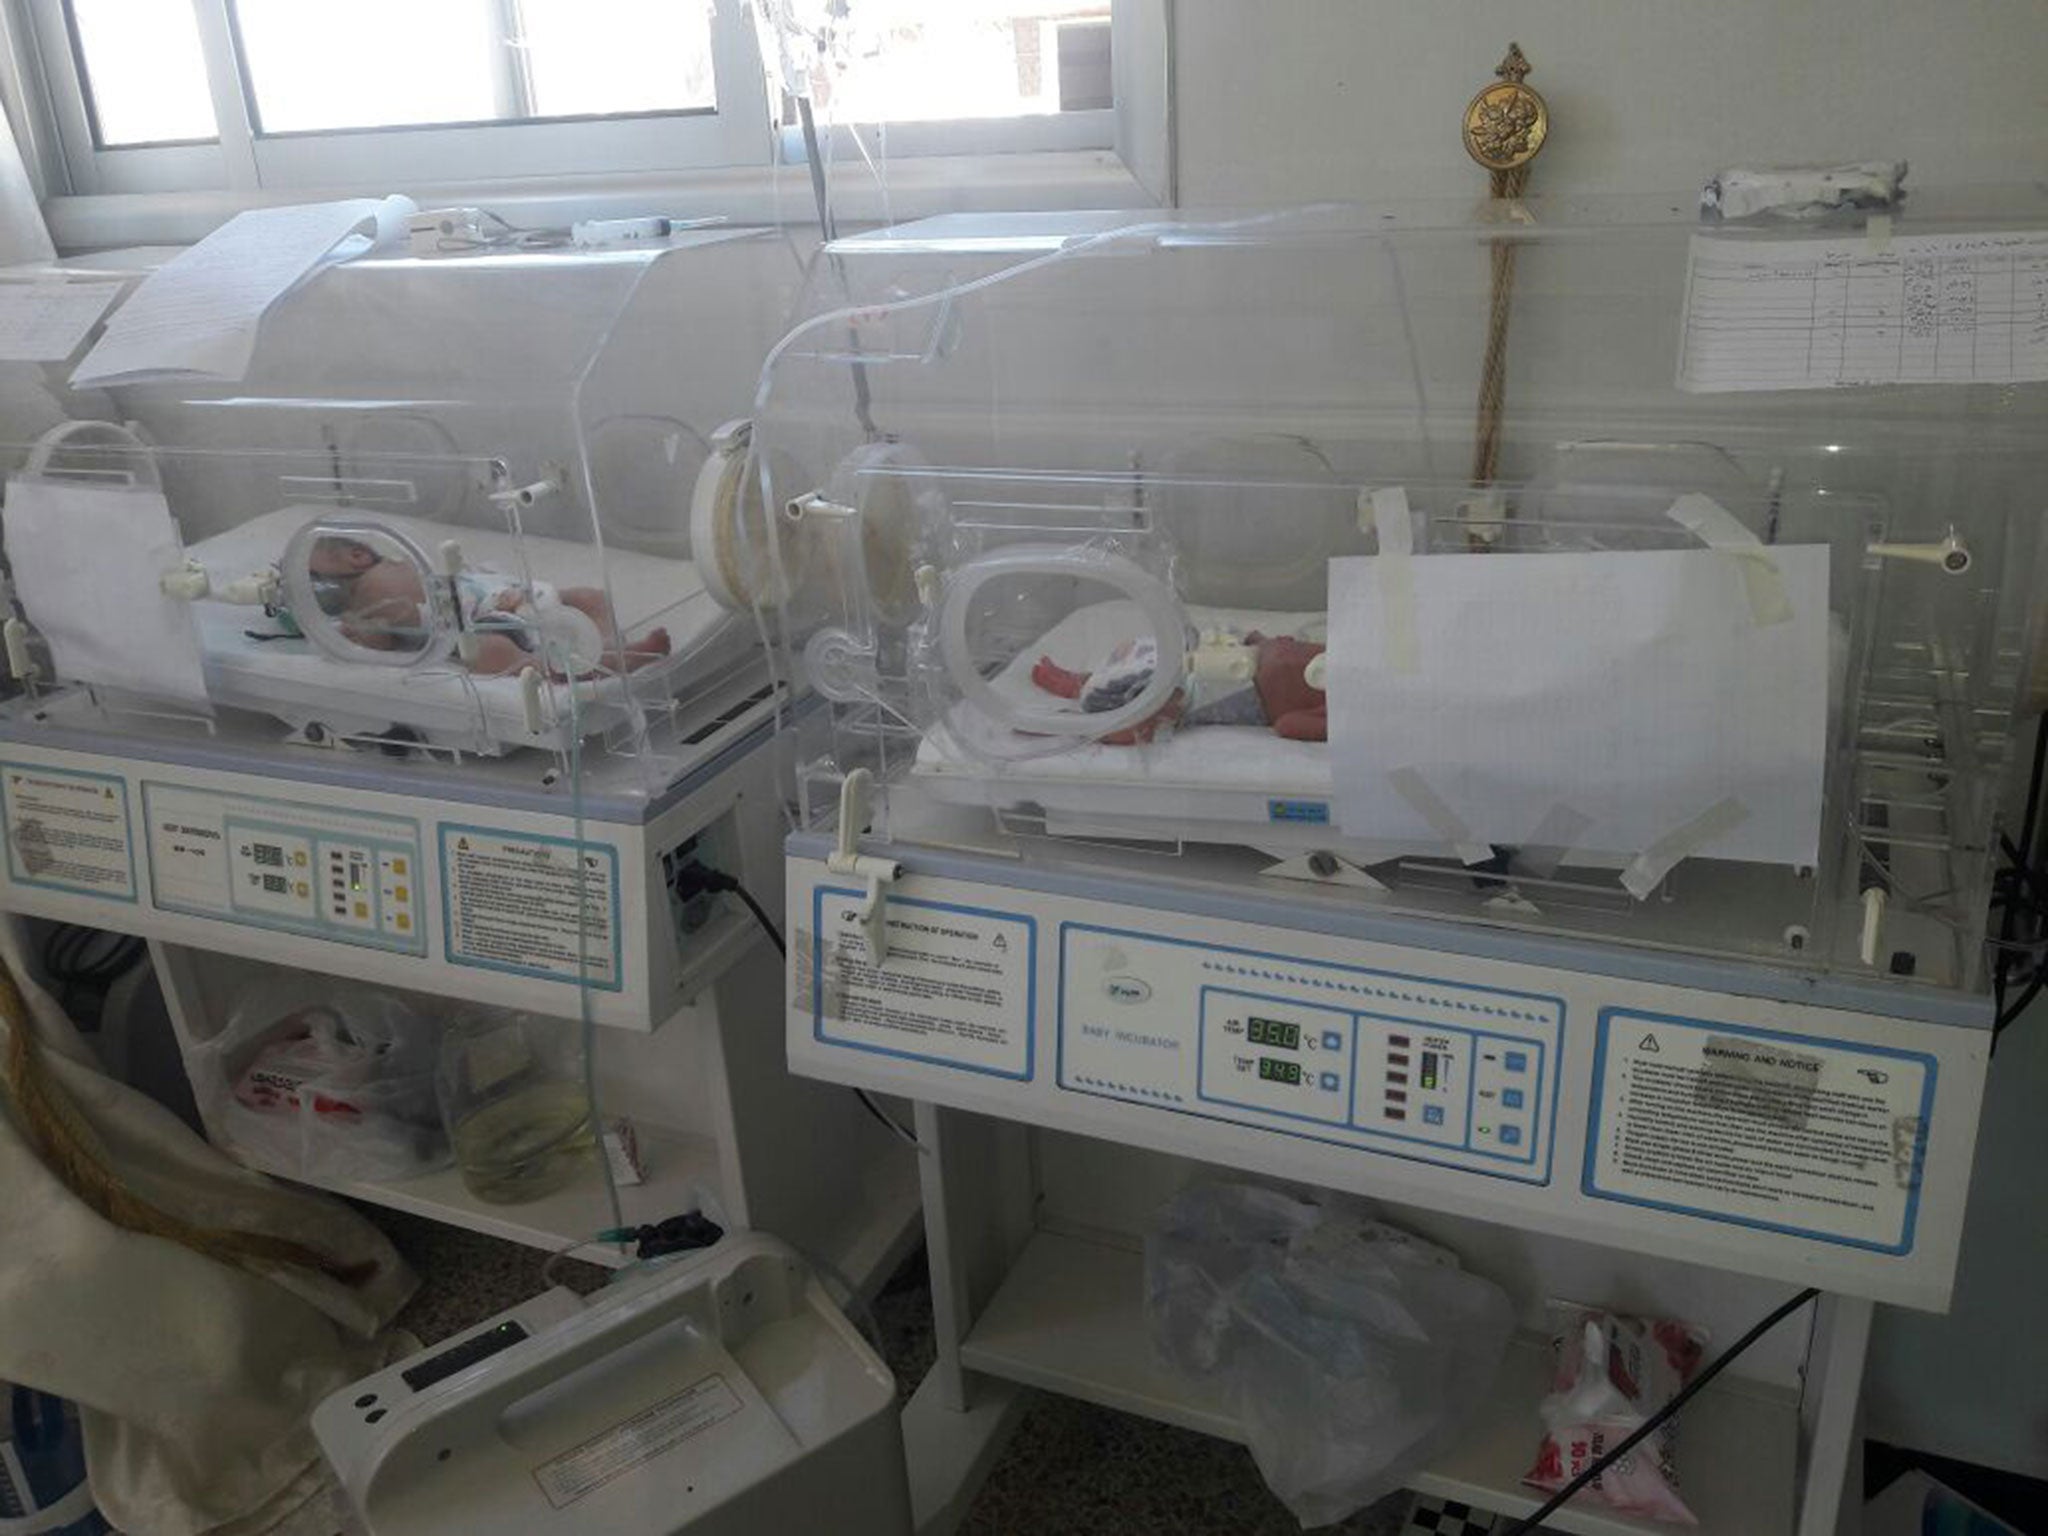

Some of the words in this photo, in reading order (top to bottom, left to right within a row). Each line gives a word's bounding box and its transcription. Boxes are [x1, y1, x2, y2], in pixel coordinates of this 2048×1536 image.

[1082, 1024, 1110, 1039] BABY
[1115, 1031, 1180, 1049] INCUBATOR
[1702, 1047, 1751, 1062] WARNING
[1753, 1055, 1777, 1066] AND
[1779, 1058, 1820, 1073] NOTICE
